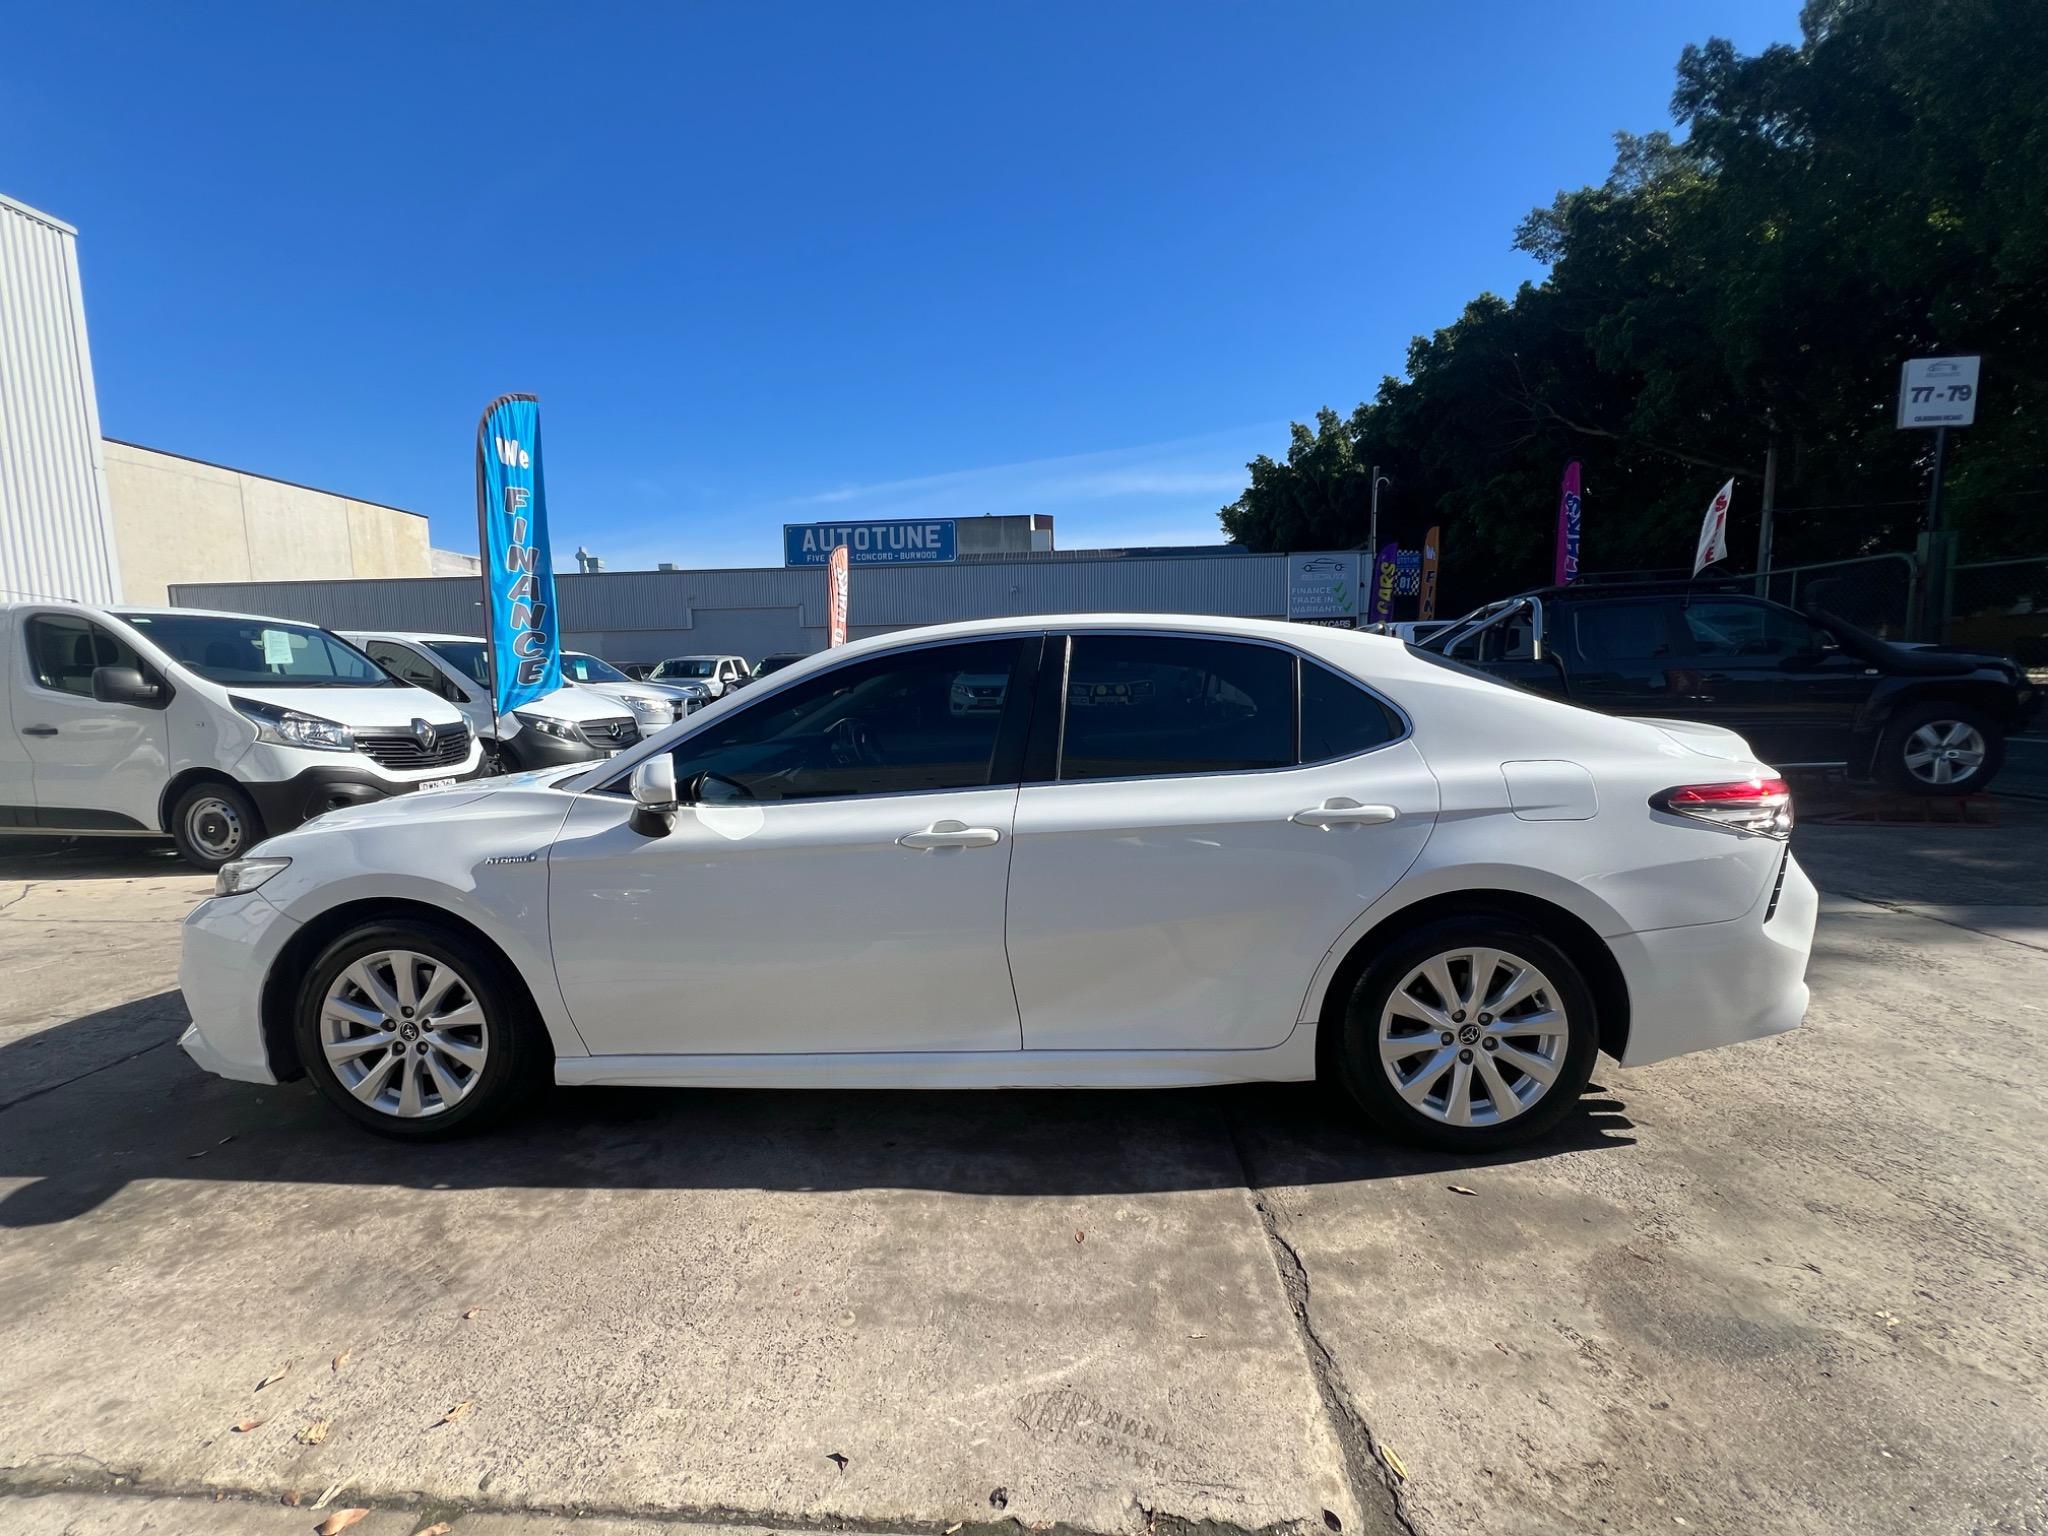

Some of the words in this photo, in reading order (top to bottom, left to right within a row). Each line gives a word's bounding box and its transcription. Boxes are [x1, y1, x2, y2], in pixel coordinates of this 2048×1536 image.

[1912, 386, 1935, 403] 77
[1947, 384, 1972, 402] 79
[496, 437, 529, 469] We
[803, 525, 942, 552] AUTOTUNE
[807, 554, 825, 562] FIVE
[856, 552, 894, 561] CONCORD
[900, 551, 937, 560] BURWOOD
[504, 486, 550, 685] FINANCE
[1292, 586, 1331, 594] FINANCE
[1376, 562, 1396, 614] CARS
[1291, 605, 1344, 614] WARRANTY
[1328, 620, 1351, 628] CARS
